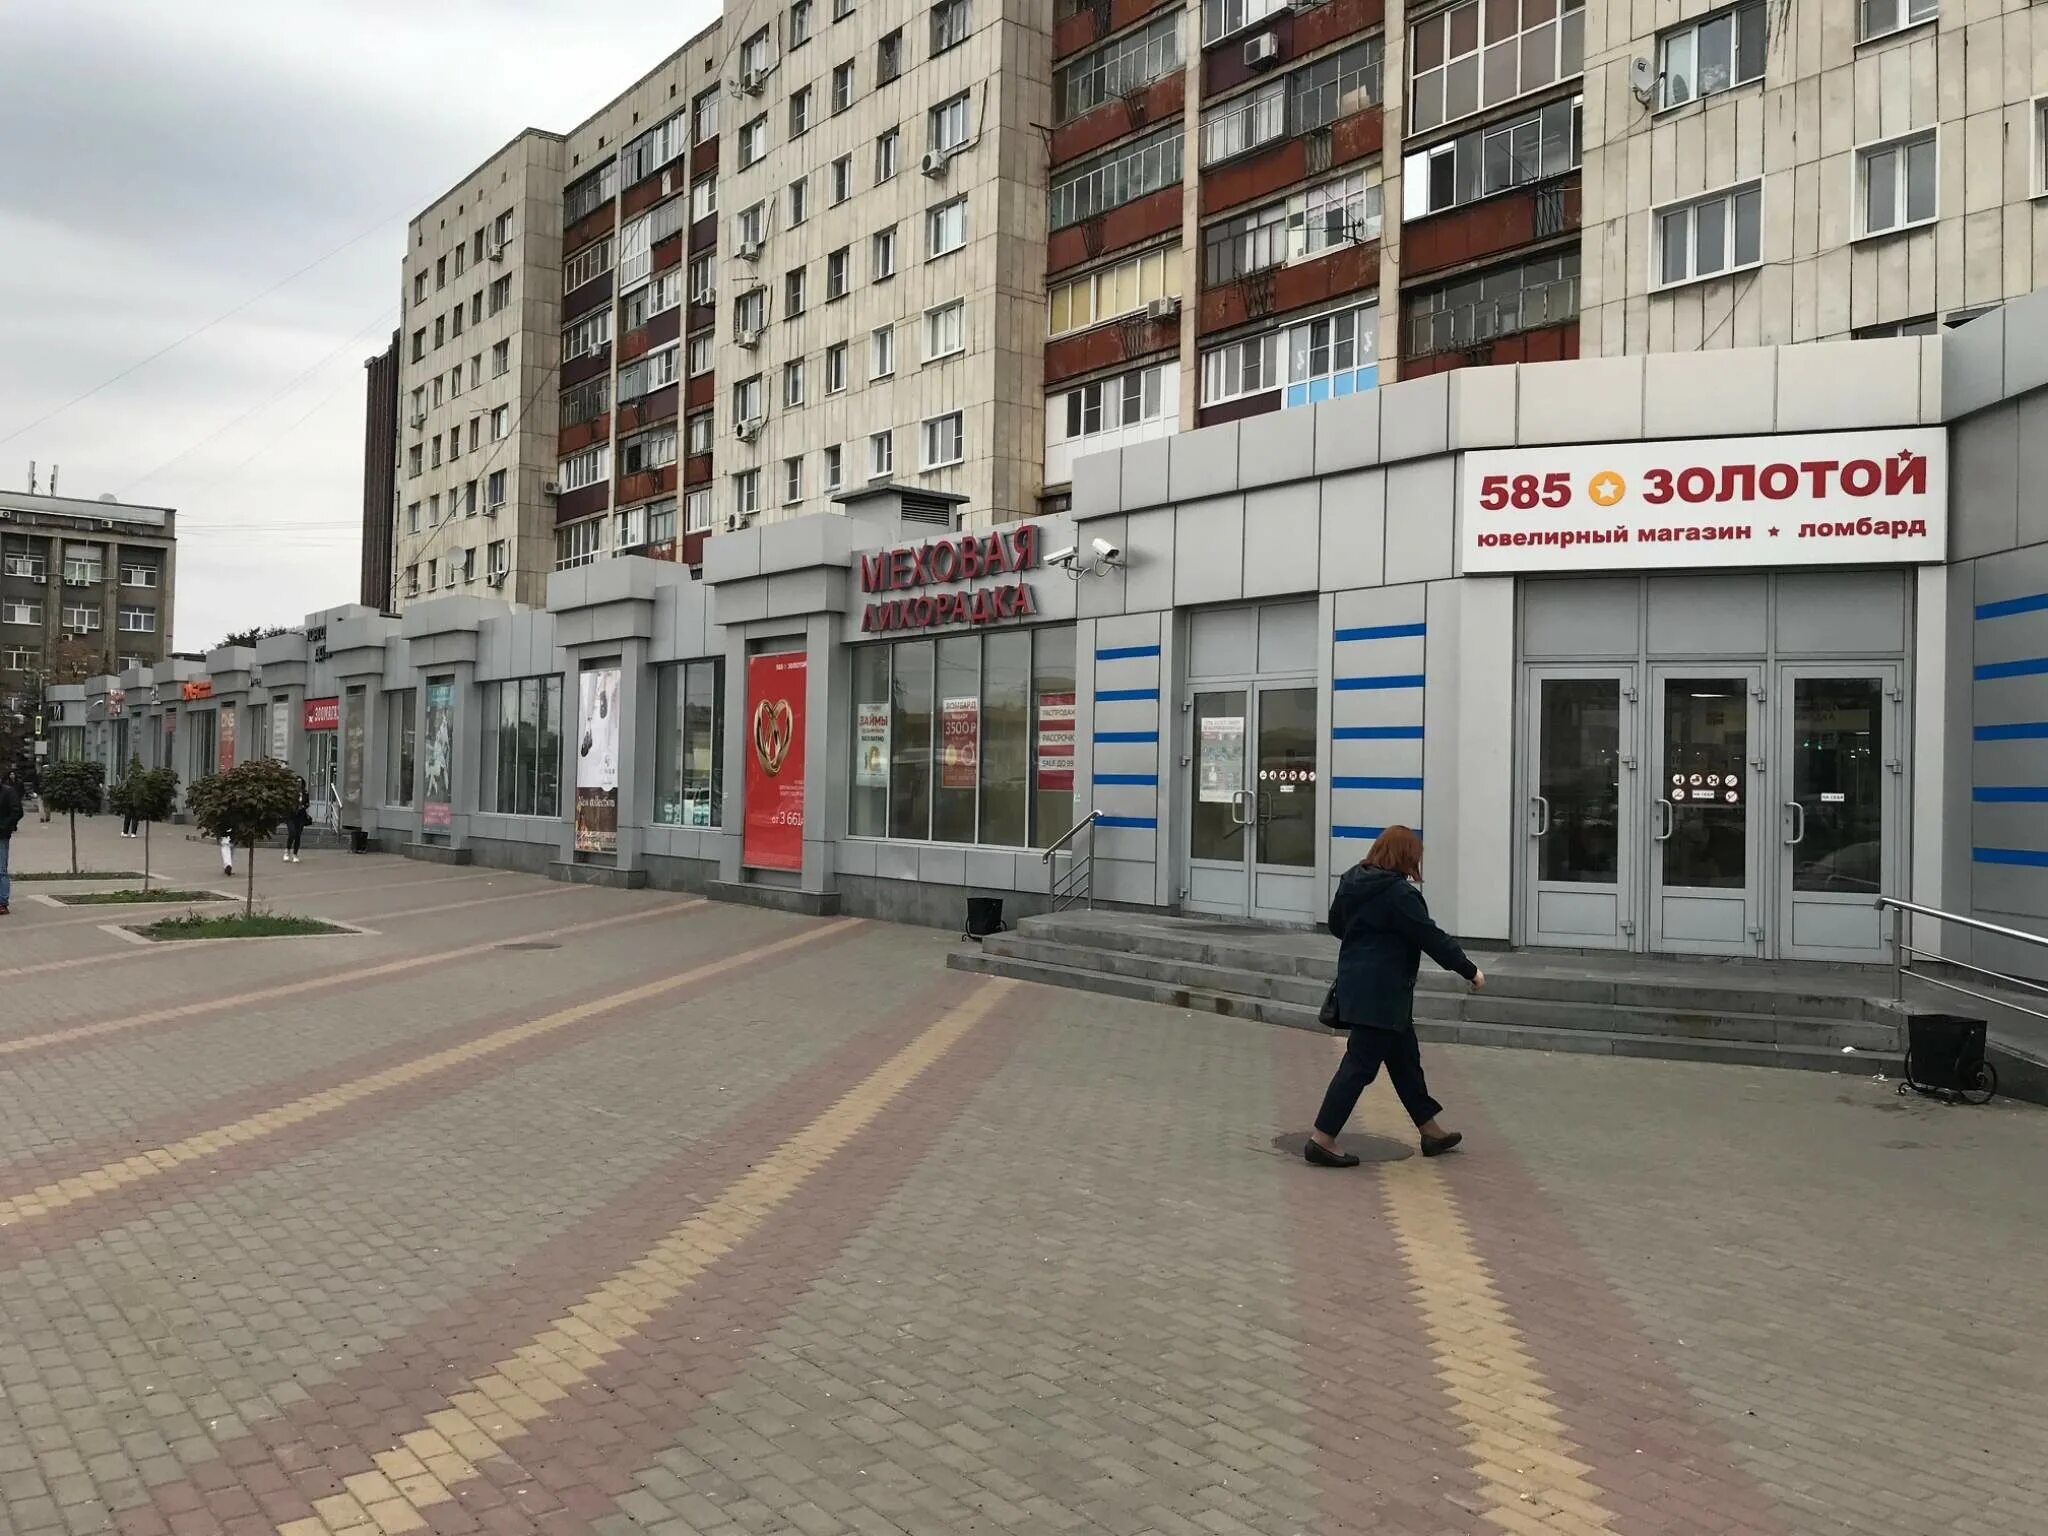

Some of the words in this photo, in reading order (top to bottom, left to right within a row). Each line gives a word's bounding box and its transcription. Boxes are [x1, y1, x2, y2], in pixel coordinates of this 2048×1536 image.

[1479, 472, 1572, 511] 585
[1642, 448, 1927, 504] ЗОЛОТОЙ
[1477, 525, 1628, 549] ювелирный
[1637, 526, 1752, 543] магазин
[1797, 516, 1927, 540] ломбард
[861, 524, 1040, 593] МЕХОВАЯ
[861, 583, 1037, 633] ЛИХОРАДКА
[859, 713, 888, 727] ЗАЙМЫ
[945, 721, 969, 736] 3500
[1042, 733, 1075, 743] РАССРОЧК
